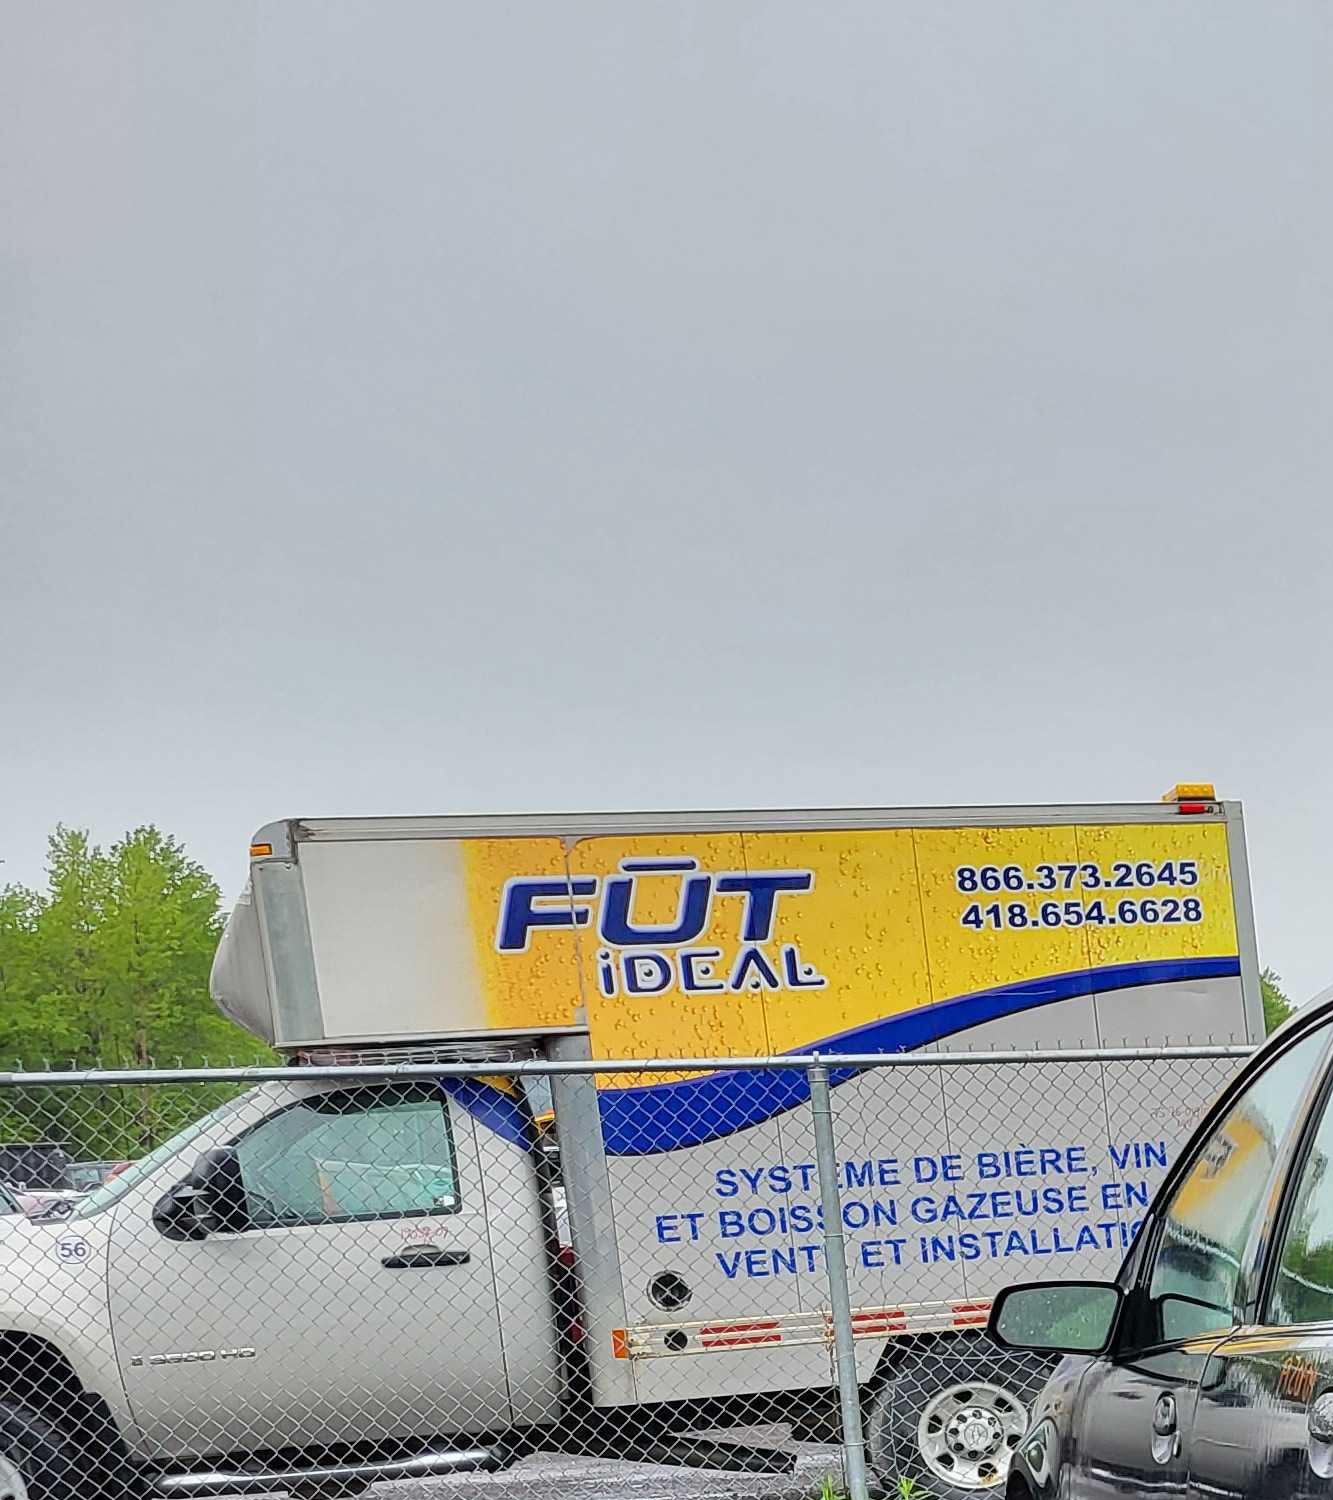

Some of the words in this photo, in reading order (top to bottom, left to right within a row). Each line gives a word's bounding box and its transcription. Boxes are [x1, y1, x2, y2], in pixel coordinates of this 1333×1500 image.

[956, 861, 1199, 892] 866.373.2645
[961, 898, 1203, 929] 418.654.6628
[714, 1158, 902, 1198] SYSTME
[913, 1154, 965, 1184] DE
[976, 1144, 1099, 1179] BIÈRE,
[1107, 1141, 1168, 1171] VIN
[655, 1212, 705, 1244] ET
[911, 1185, 1090, 1225] GAZEUSE
[1101, 1181, 1150, 1211] EN
[60, 1242, 87, 1259] 56
[715, 1244, 821, 1280] VENT
[861, 1238, 907, 1269] ET
